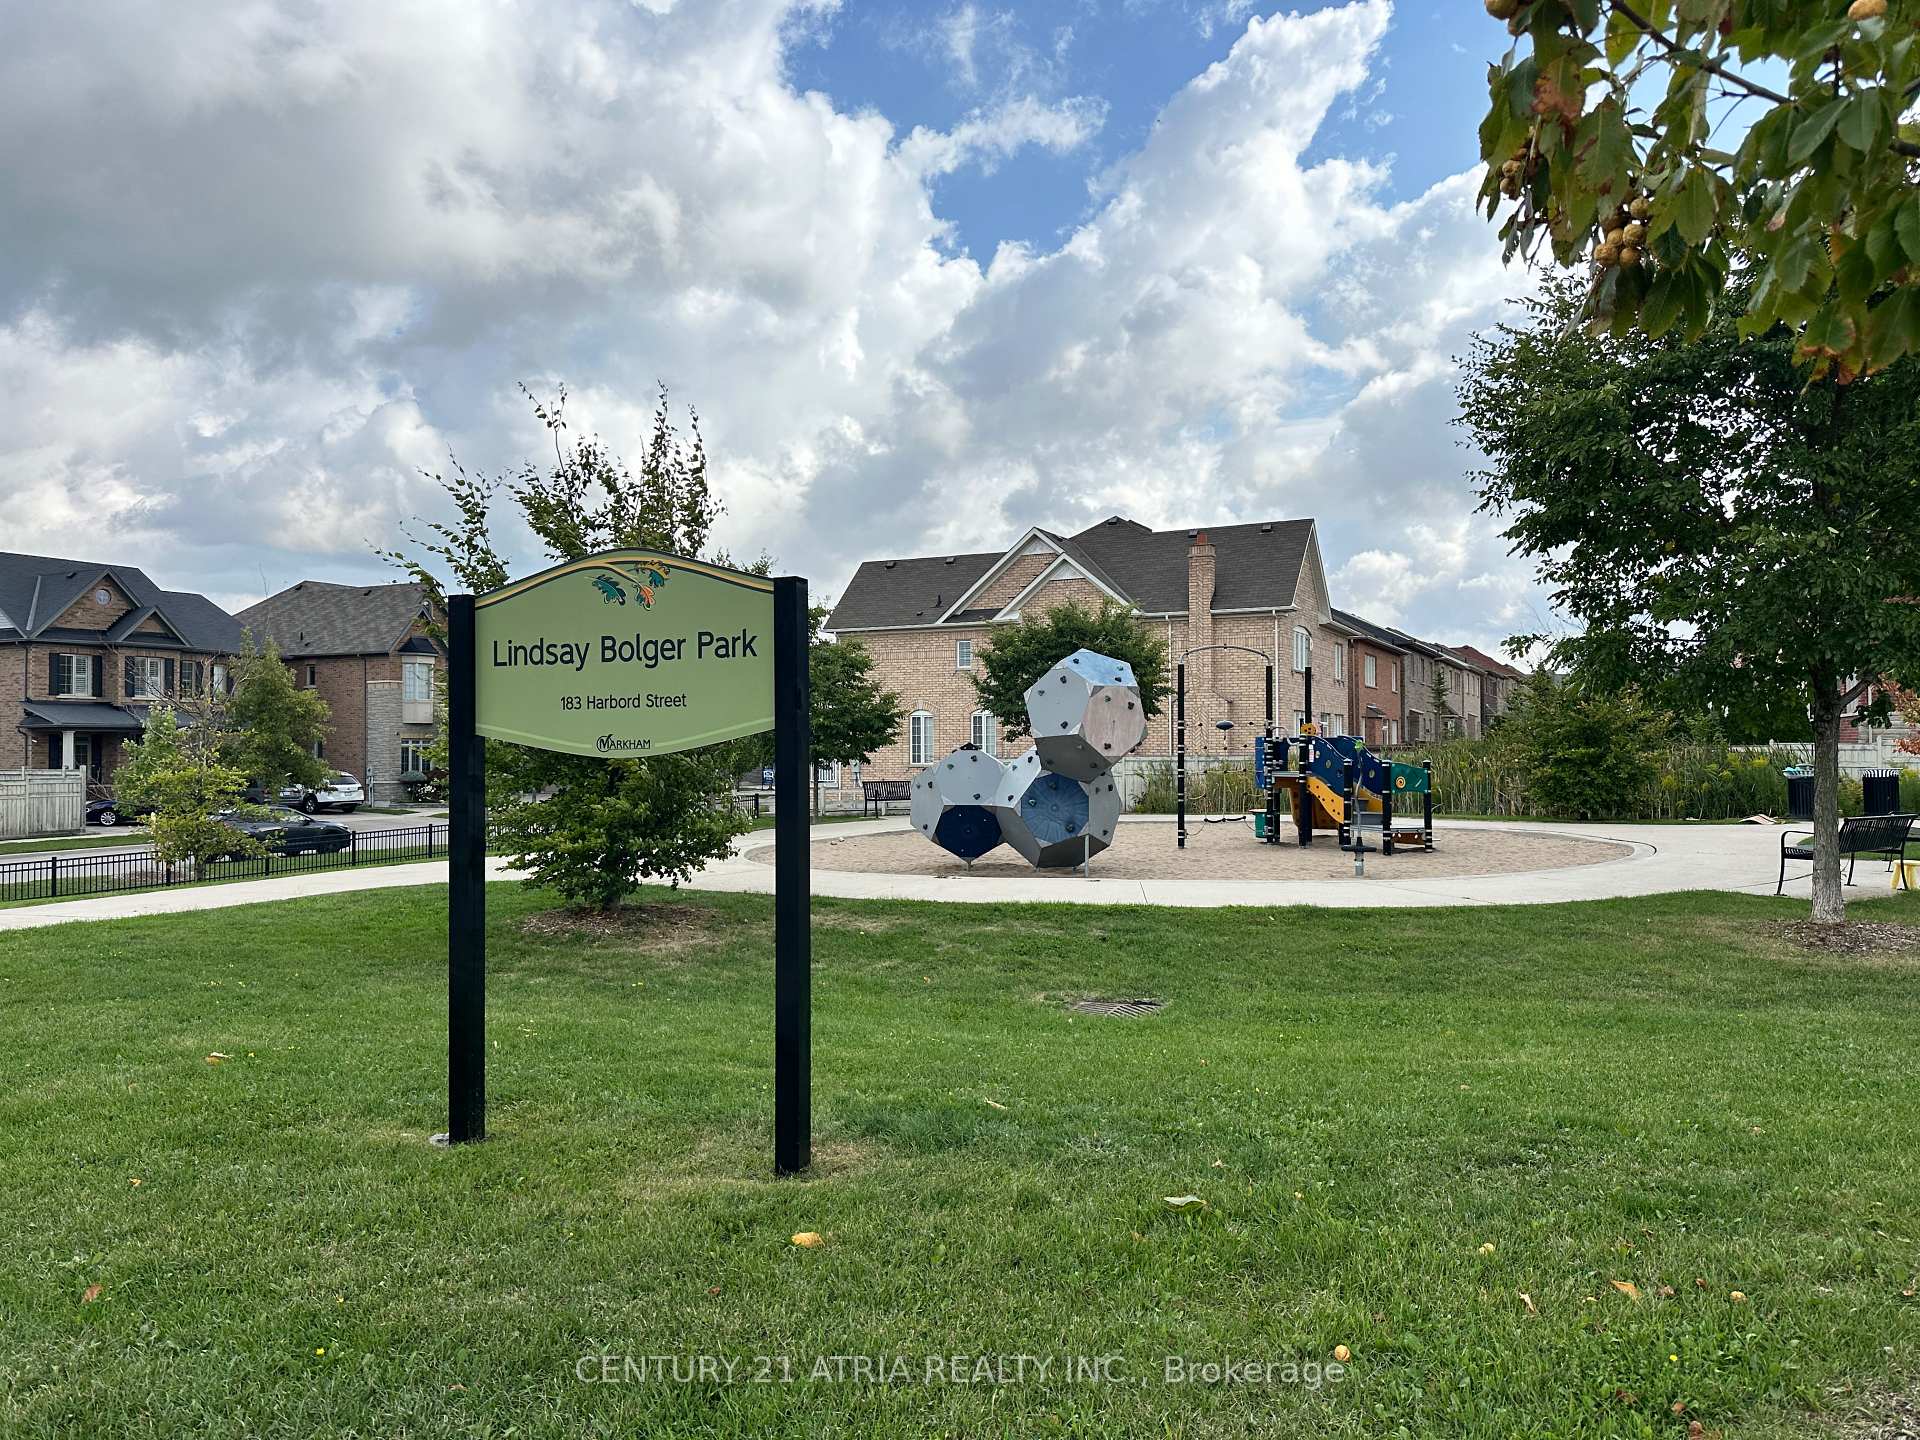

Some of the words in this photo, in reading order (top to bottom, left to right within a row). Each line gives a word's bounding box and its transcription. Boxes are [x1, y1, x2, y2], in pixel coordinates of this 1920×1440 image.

[493, 637, 590, 671] Lindsay
[601, 632, 686, 669] Bolger
[697, 628, 758, 659] Park
[560, 696, 582, 711] 183
[586, 693, 641, 710] Harbord
[646, 693, 687, 709] Street
[597, 734, 651, 752] MARKHAM
